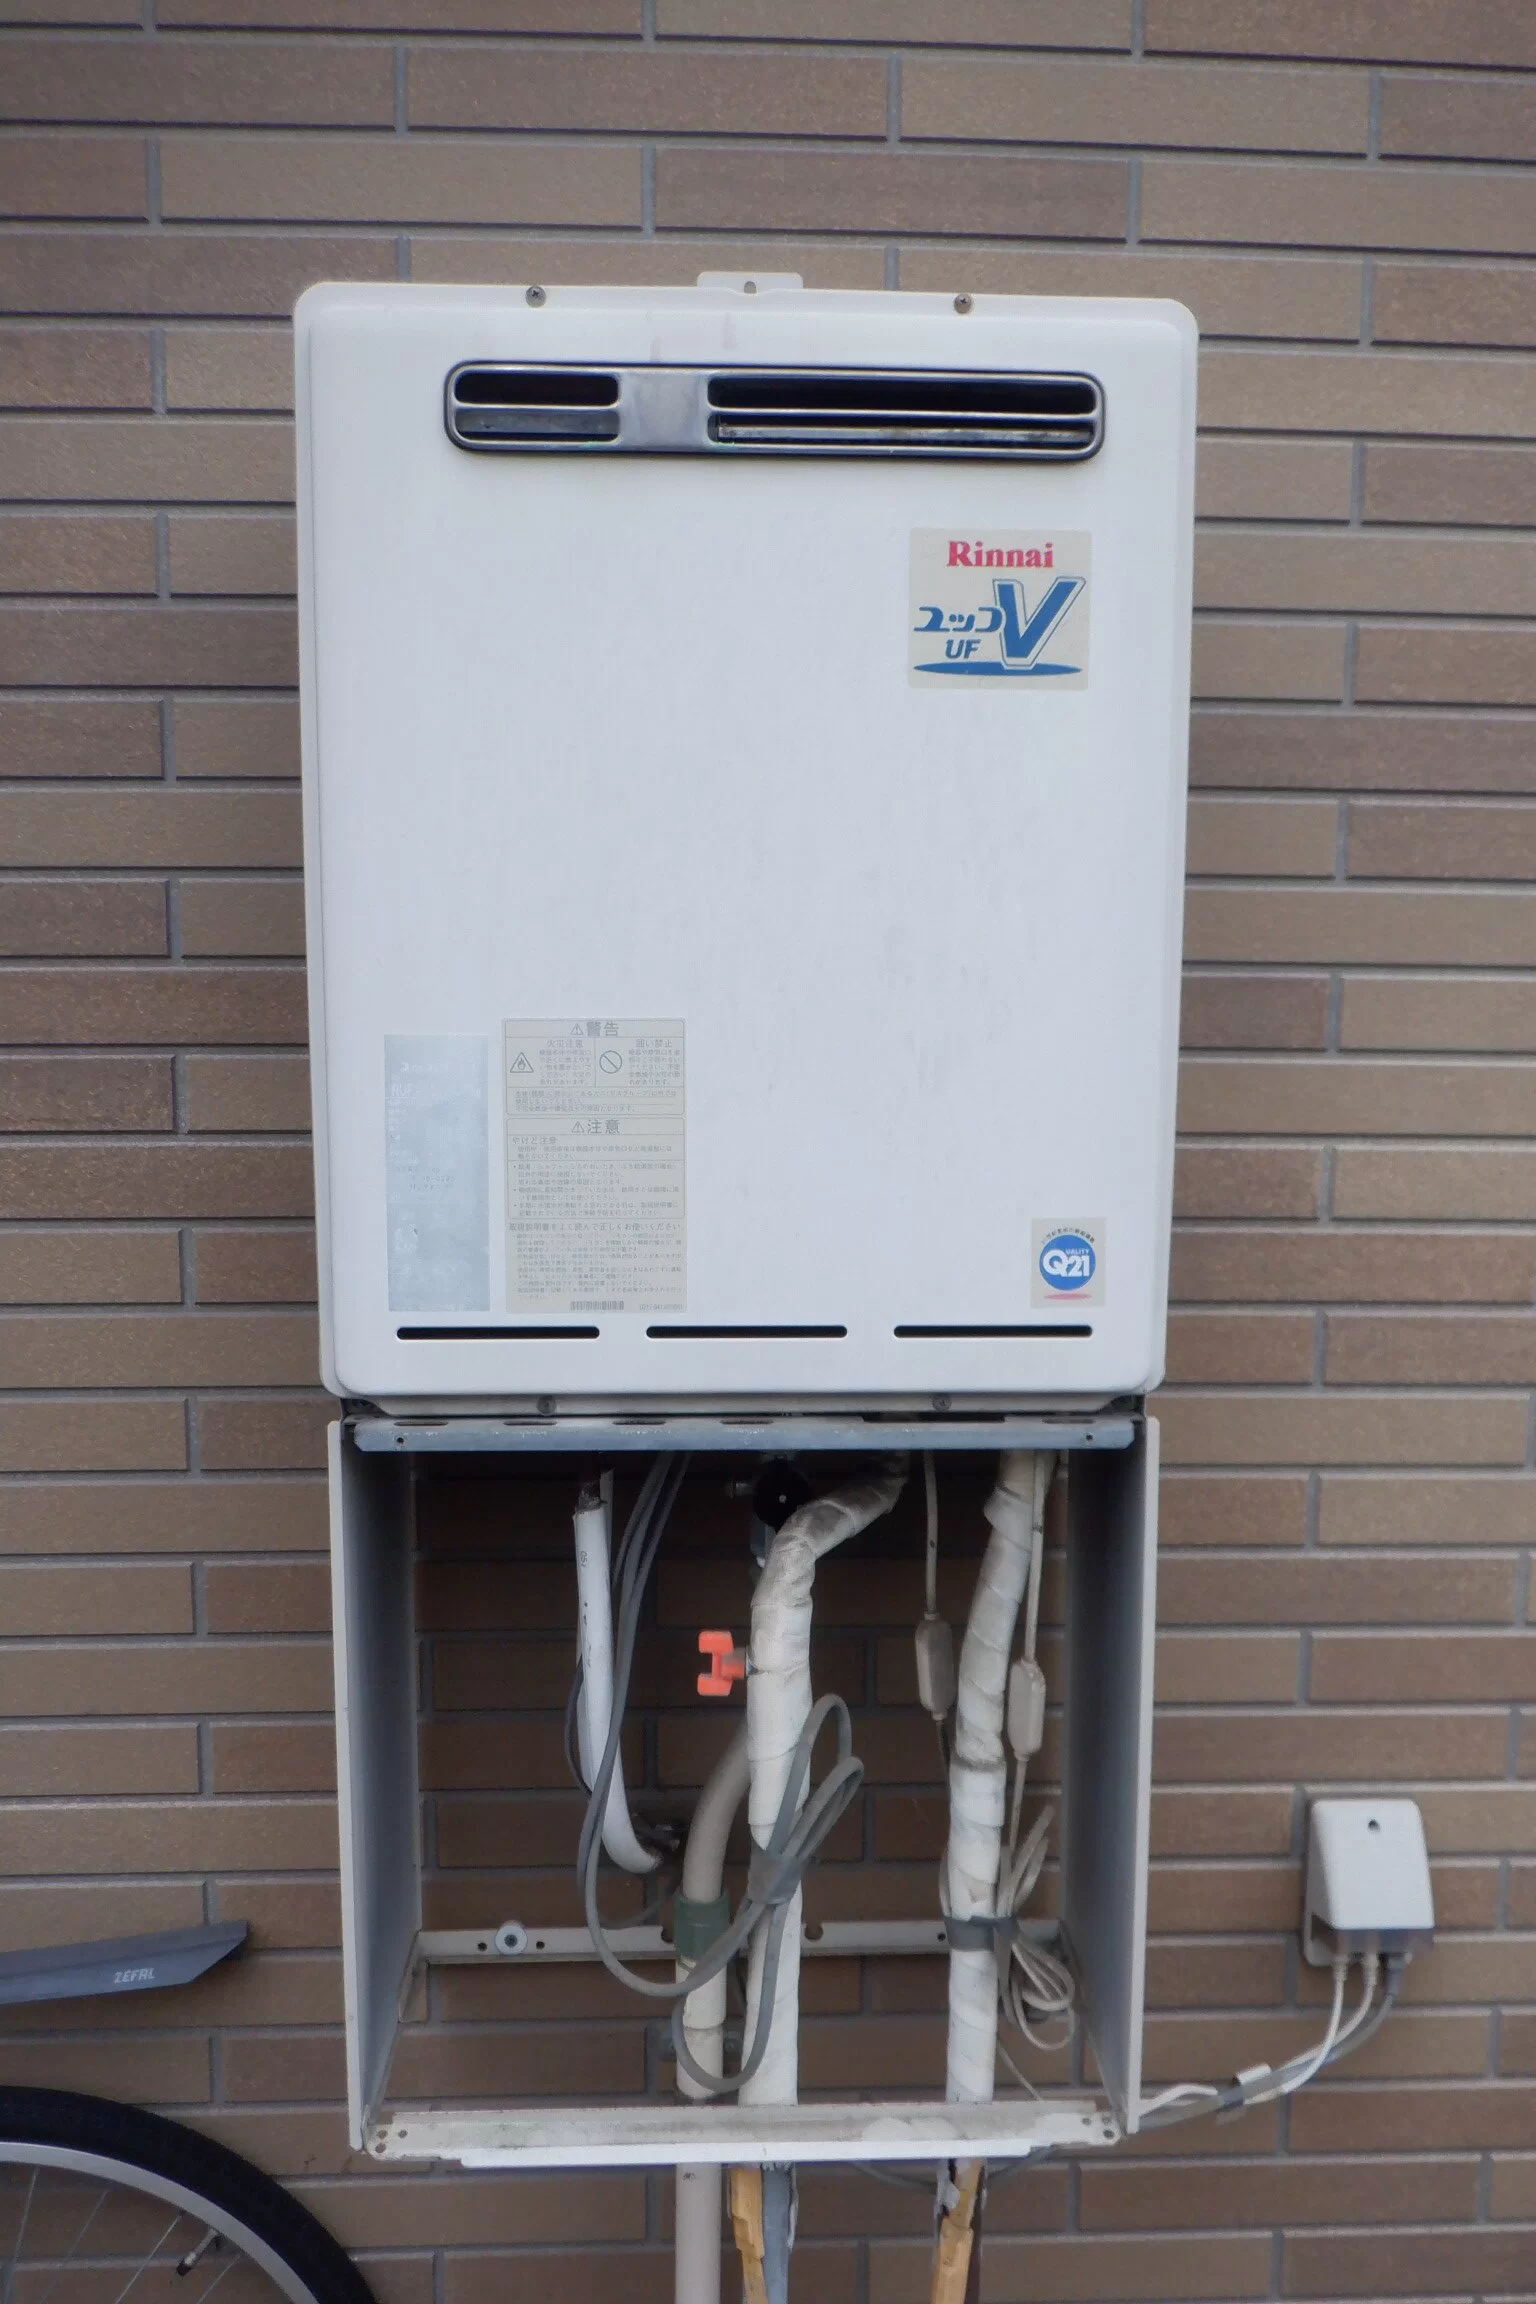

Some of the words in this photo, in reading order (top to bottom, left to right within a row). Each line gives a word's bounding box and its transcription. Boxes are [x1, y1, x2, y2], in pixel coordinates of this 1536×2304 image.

[946, 540, 1053, 568] Rinnai
[945, 638, 982, 659] UF
[586, 1021, 619, 1037] 警告
[587, 1119, 621, 1135] 注意
[113, 1967, 156, 1984] ZEFAL
